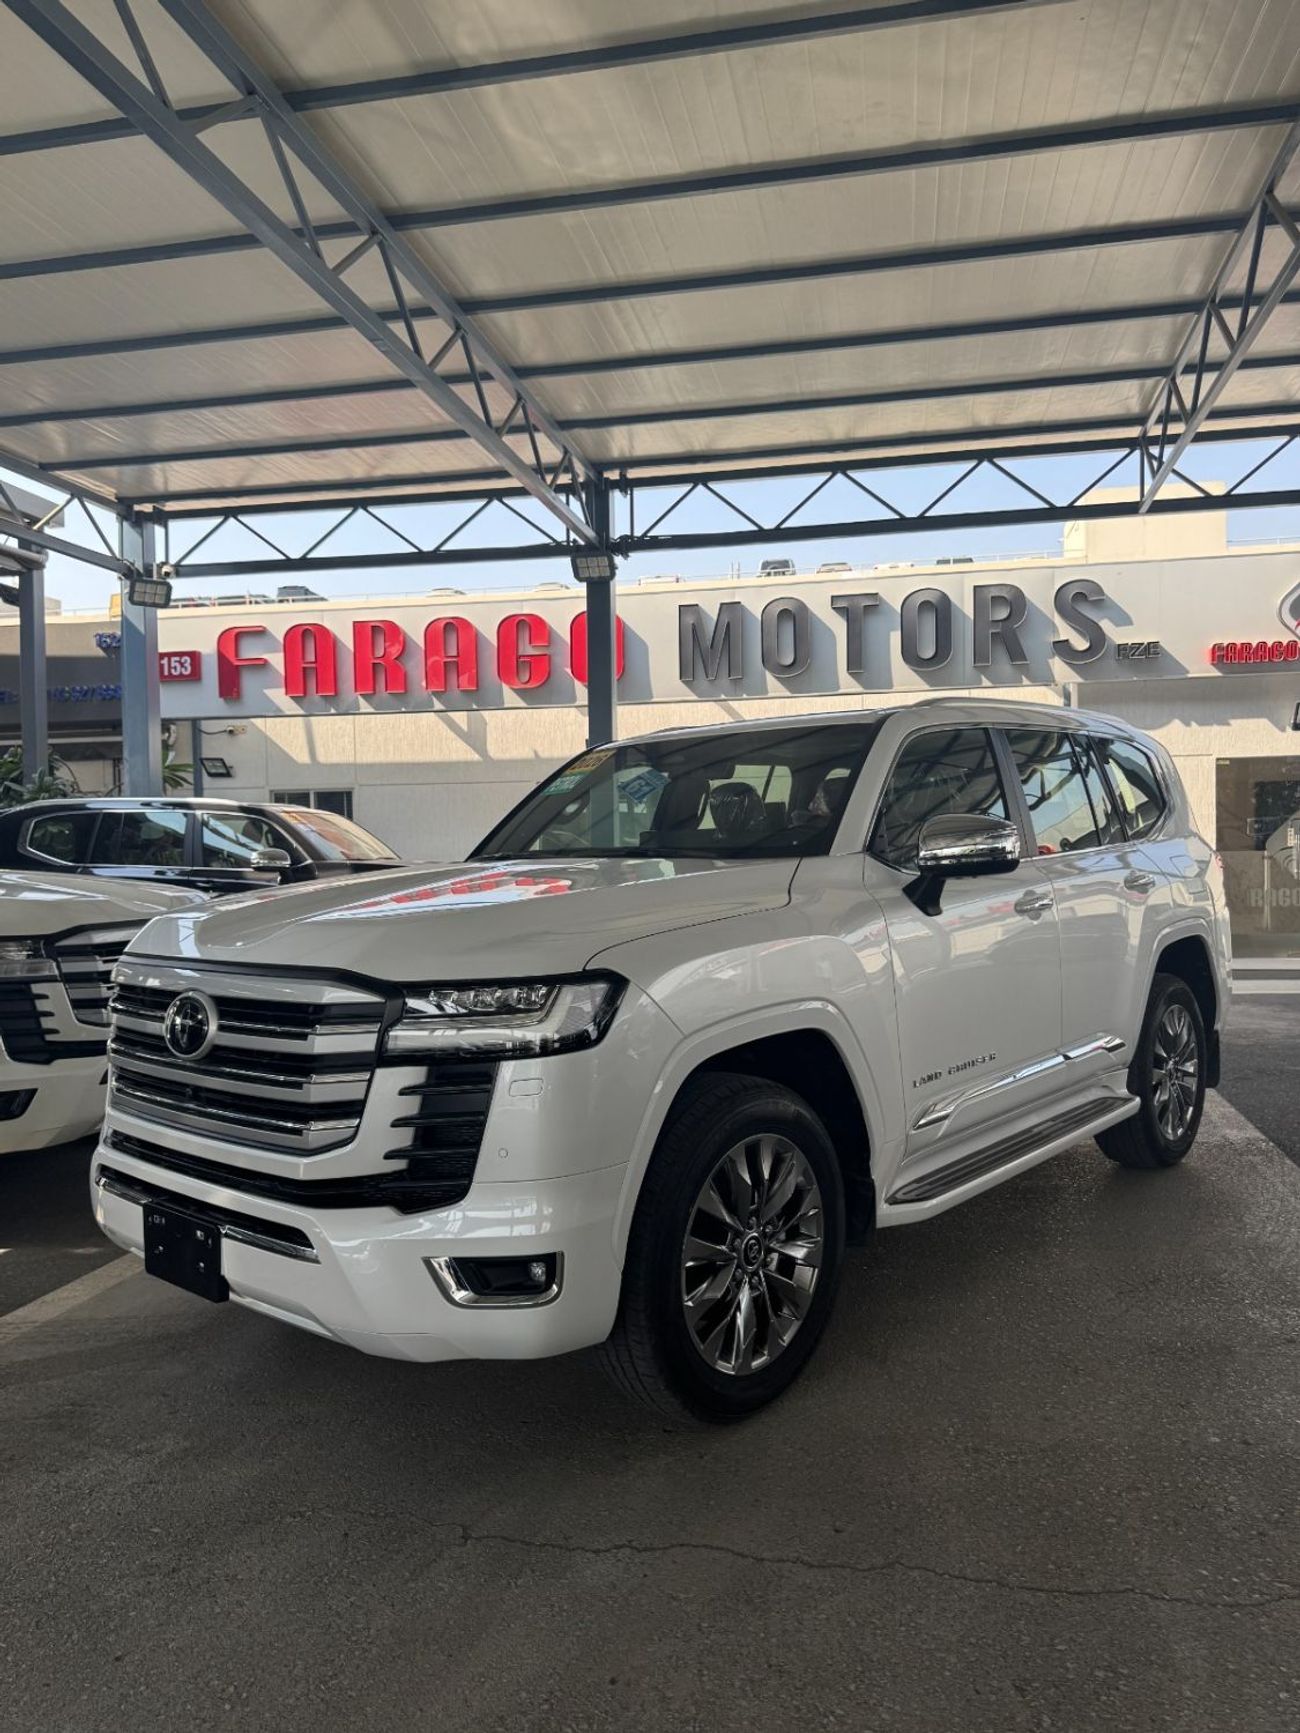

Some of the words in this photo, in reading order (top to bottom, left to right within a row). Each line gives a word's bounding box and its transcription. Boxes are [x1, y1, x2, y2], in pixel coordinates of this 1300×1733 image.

[678, 578, 1107, 682] MOTORS
[1116, 641, 1161, 661] FZE
[1211, 640, 1300, 665] FARAGO
[160, 656, 192, 676] 153
[913, 1069, 942, 1089] LAND
